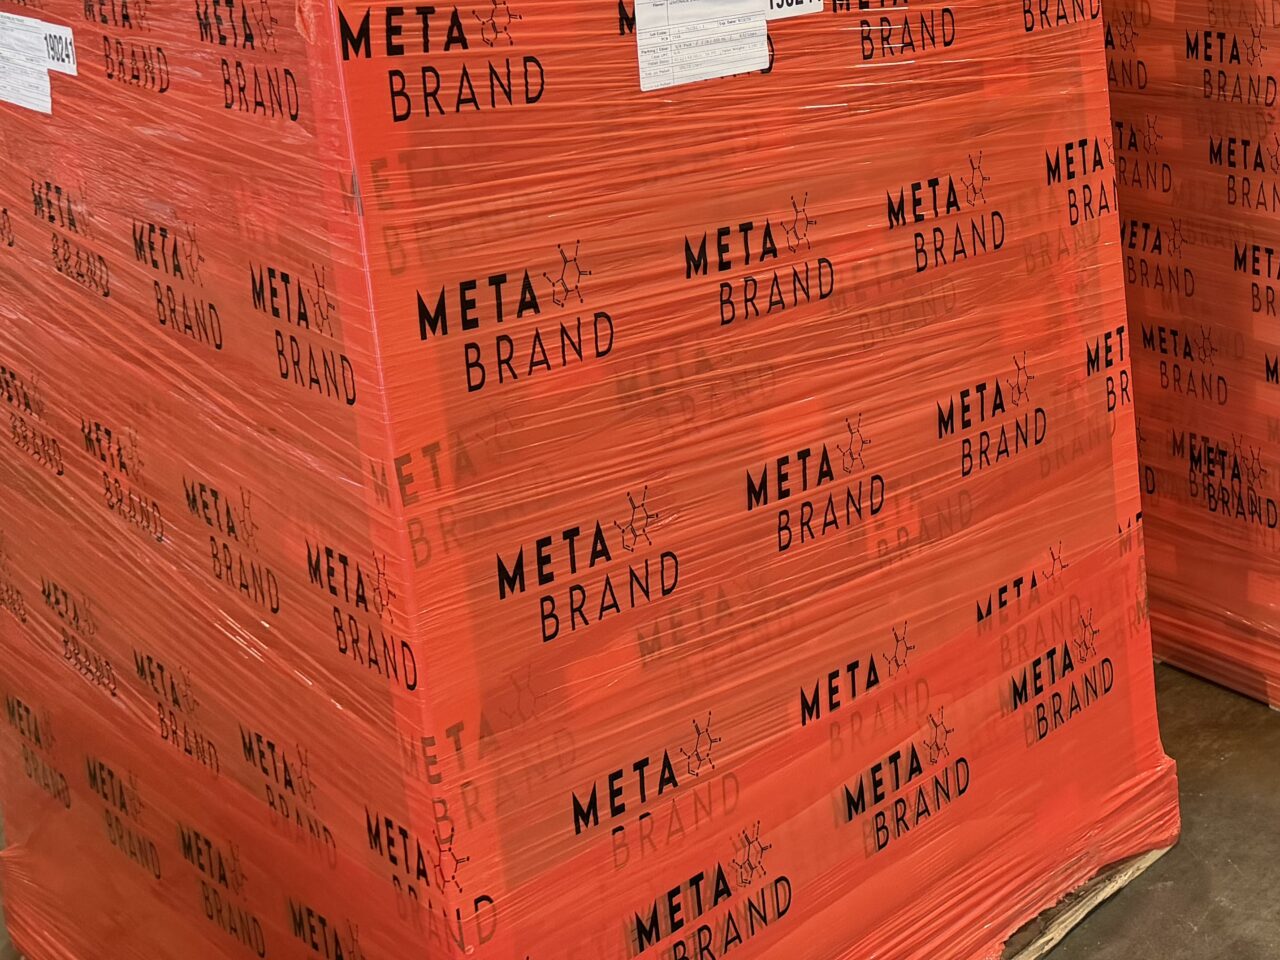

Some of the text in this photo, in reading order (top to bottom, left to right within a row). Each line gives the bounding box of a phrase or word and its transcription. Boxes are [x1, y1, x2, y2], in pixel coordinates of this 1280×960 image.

[104, 37, 170, 93] BRAND
[339, 5, 469, 61] META
[860, 7, 956, 61] BRAND
[1186, 28, 1240, 64] META
[221, 59, 299, 121] BRAND
[389, 56, 545, 123] BRAND
[1204, 68, 1277, 108] BRAND
[1045, 136, 1104, 186] META
[1209, 136, 1264, 173] META
[31, 179, 76, 236] META
[887, 174, 960, 230] META
[51, 234, 109, 297] BRAND
[132, 224, 184, 281] META
[684, 221, 779, 280] META
[914, 210, 1005, 273] BRAND
[250, 262, 309, 329] META
[416, 268, 541, 341] META
[719, 257, 834, 327] BRAND
[1128, 256, 1195, 297] BRAND
[153, 281, 223, 350] BRAND
[1142, 323, 1194, 362] META
[276, 330, 356, 406] BRAND
[465, 311, 614, 392] BRAND
[1160, 361, 1228, 405] BRAND
[936, 376, 1005, 440] META
[81, 418, 129, 476] META
[961, 407, 1047, 478] BRAND
[101, 471, 164, 543] BRAND
[183, 476, 238, 540] META
[746, 443, 836, 511] META
[777, 474, 886, 552] BRAND
[210, 536, 280, 614] BRAND
[306, 541, 369, 610] META
[496, 520, 613, 600] META
[540, 550, 680, 643] BRAND
[976, 570, 1039, 624] META
[133, 650, 181, 713] META
[333, 606, 417, 690] BRAND
[1011, 640, 1074, 710] META
[6, 694, 42, 746] META
[801, 652, 880, 727] META
[1035, 656, 1114, 740] BRAND
[157, 704, 219, 780] BRAND
[239, 725, 294, 794] META
[22, 747, 70, 809] BRAND
[86, 756, 130, 818] META
[571, 748, 679, 835] META
[844, 742, 923, 823] META
[874, 756, 970, 851] BRAND
[107, 815, 161, 879] BRAND
[366, 806, 430, 885] META
[611, 772, 741, 870] BRAND
[179, 824, 229, 888] META
[205, 882, 265, 958] BRAND
[290, 899, 345, 960] META
[634, 862, 731, 955] META
[673, 875, 792, 960] BRAND
